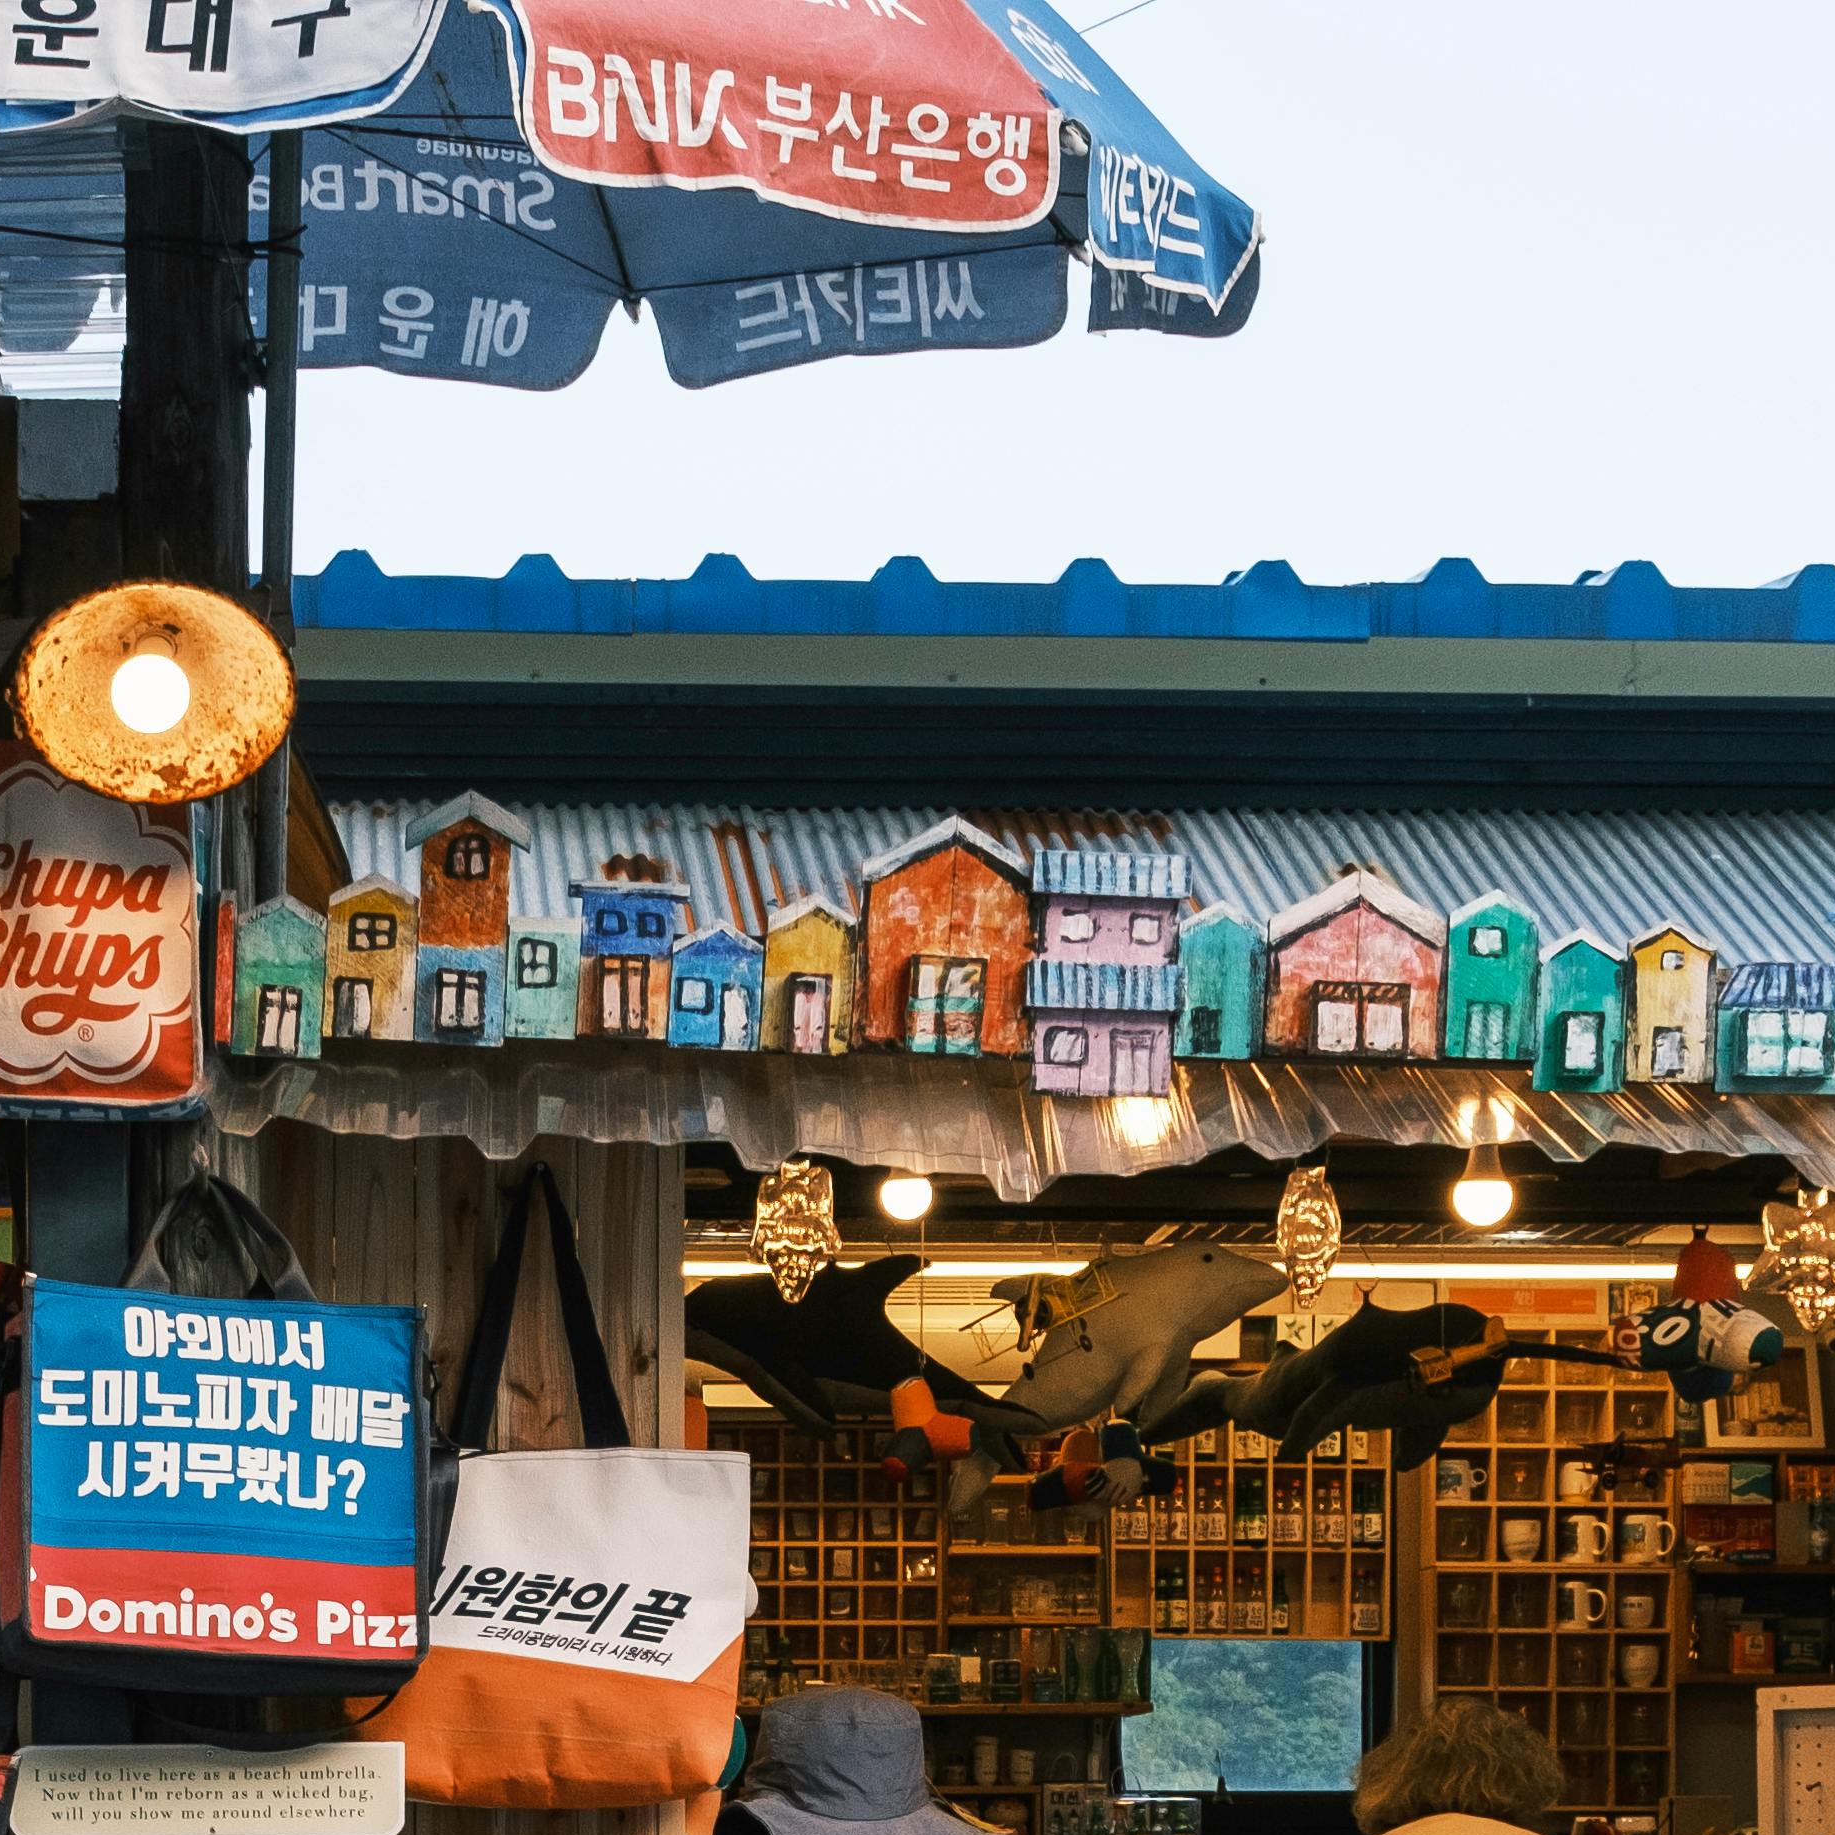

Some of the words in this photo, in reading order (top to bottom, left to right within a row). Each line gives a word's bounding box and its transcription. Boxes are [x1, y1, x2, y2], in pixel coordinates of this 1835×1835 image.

[546, 46, 747, 149] BNK
[757, 76, 1031, 198] 부산은행
[123, 1307, 325, 1371] 야외에서
[38, 1369, 298, 1437] 도미노피자
[312, 1380, 411, 1449] 배달
[43, 1585, 298, 1645] Domino's
[620, 1588, 694, 1644] 끝
[476, 1624, 590, 1656] 드라이공법이라
[589, 1640, 614, 1657] 더
[607, 1643, 674, 1667] 시원하다
[33, 1768, 42, 1782] I
[48, 1768, 87, 1782] used
[95, 1768, 112, 1782] to
[119, 1768, 152, 1782] live
[158, 1768, 196, 1782] here
[203, 1770, 221, 1782] as
[227, 1771, 237, 1782] a
[243, 1767, 292, 1781] beach
[299, 1766, 383, 1781] umbrella.
[41, 1788, 81, 1802] Now
[88, 1788, 124, 1802] that
[131, 1786, 159, 1801] I'm
[165, 1787, 224, 1801] reborn
[230, 1790, 248, 1800] as
[272, 1786, 331, 1800] wicked
[338, 1785, 375, 1804] bag,
[51, 1806, 84, 1821] will
[91, 1809, 123, 1825] you
[129, 1807, 174, 1820] show
[180, 1809, 206, 1820] me
[211, 1806, 273, 1820] around
[279, 1805, 367, 1819] elsewhere
